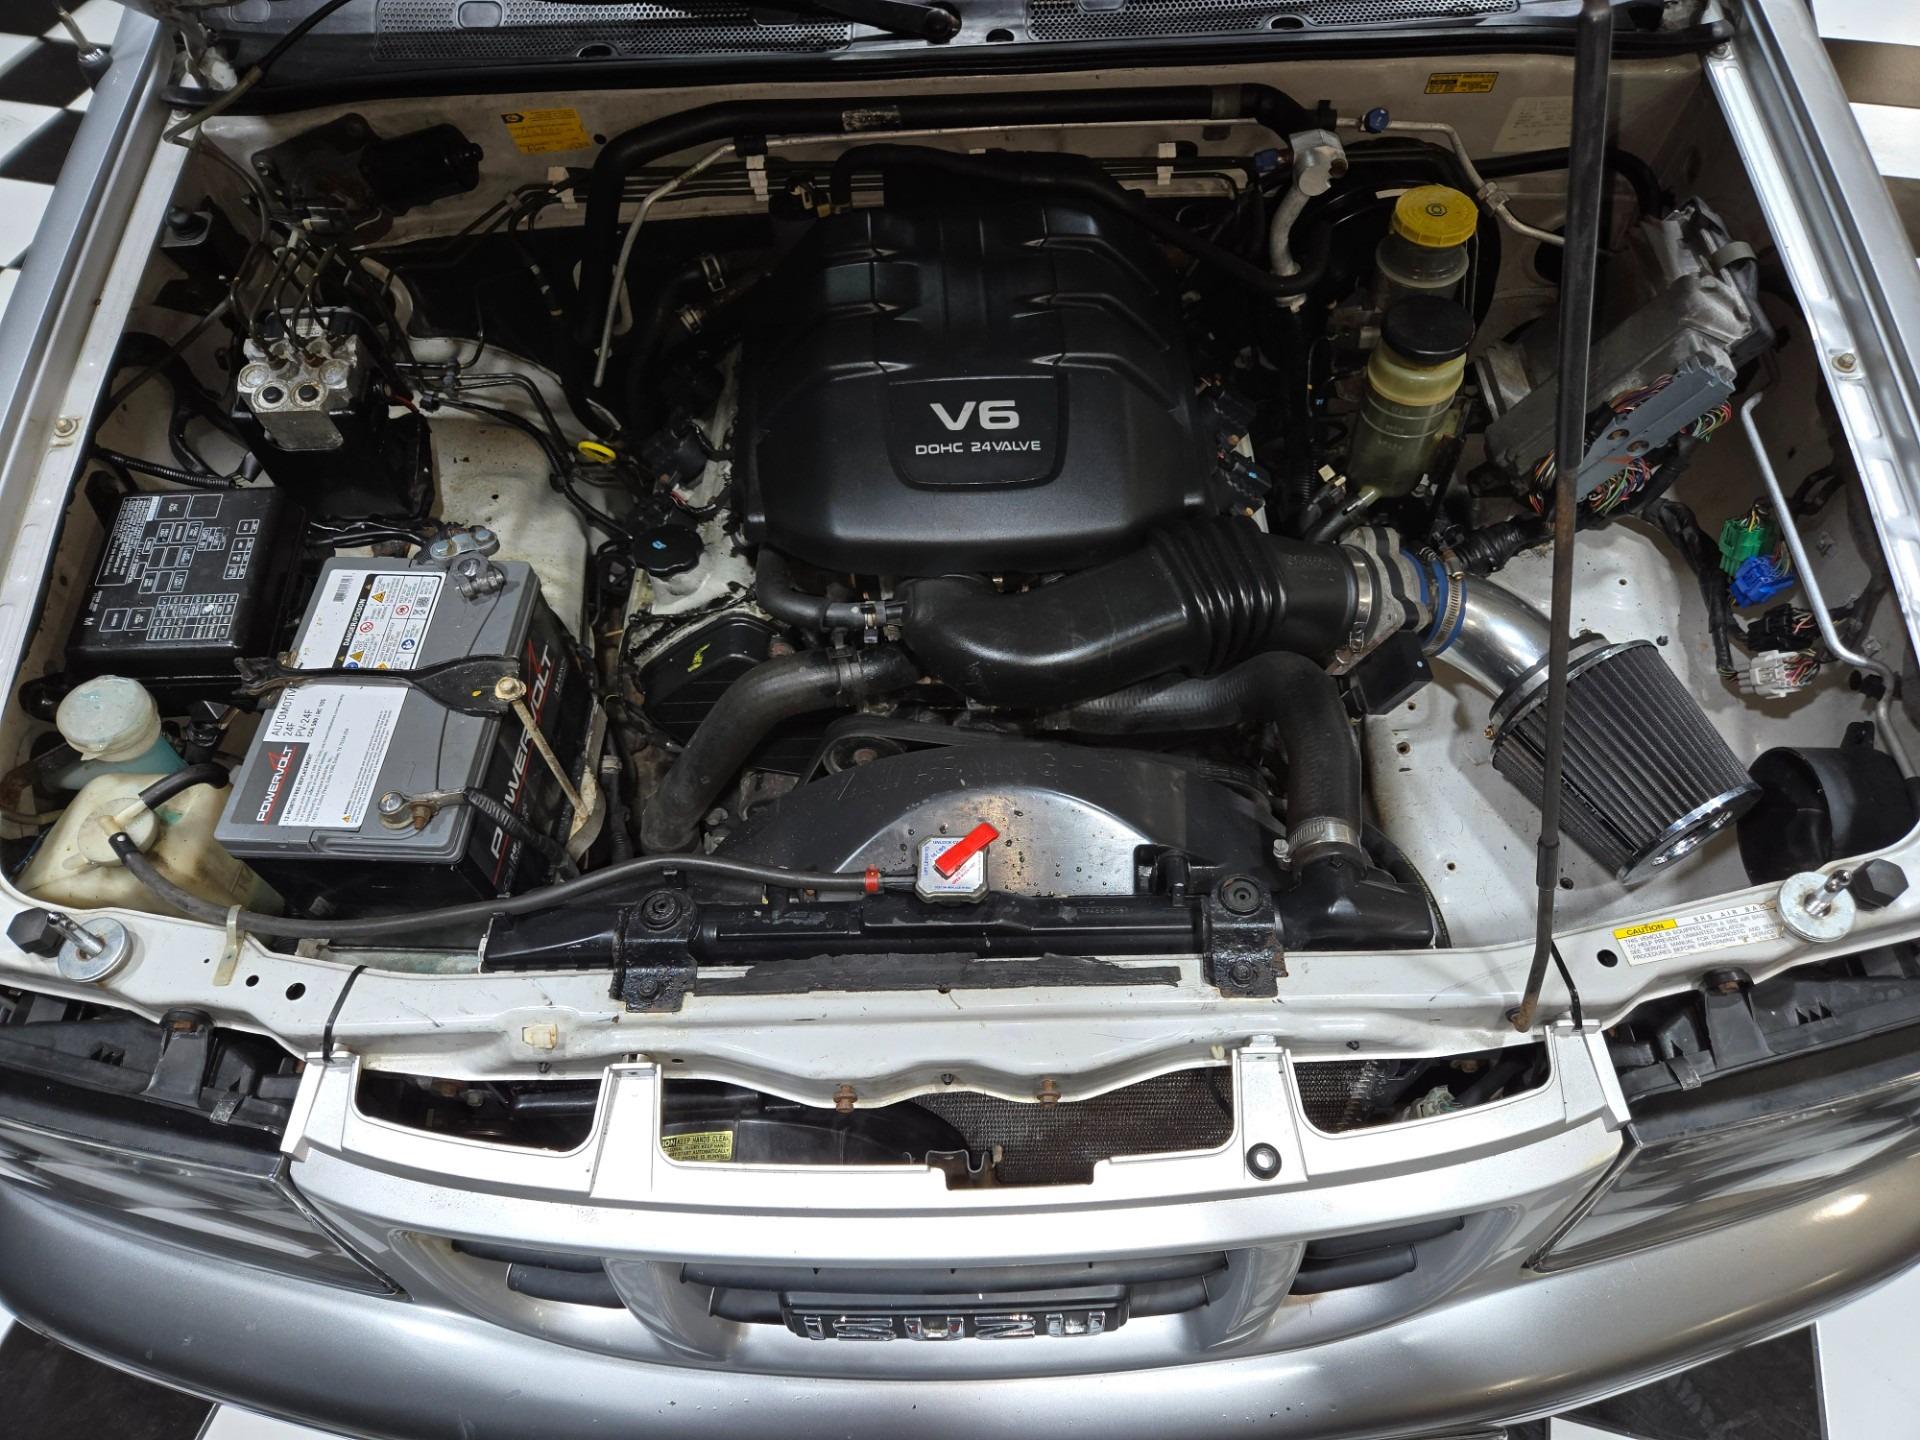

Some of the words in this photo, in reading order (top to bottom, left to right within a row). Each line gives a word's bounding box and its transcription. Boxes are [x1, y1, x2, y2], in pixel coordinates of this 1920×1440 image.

[929, 400, 1020, 430] V6
[915, 442, 964, 455] DOHC
[970, 440, 1041, 453] 24VALVE
[342, 598, 366, 645] DANGER/POISON
[283, 722, 294, 737] 24F
[295, 709, 313, 737] PV-24F
[256, 745, 292, 822] POWERVOLT
[1625, 923, 1664, 935] CAUTION
[1639, 932, 1664, 941] VEHICLE
[1671, 925, 1702, 935] EQUIPPED
[1643, 943, 1667, 951] SERVICE
[1669, 938, 1695, 946] MANUAL
[1710, 928, 1746, 939] DIAGNOSTIC
[1653, 934, 1681, 944] PREVENT
[1682, 928, 1715, 938] UNWANTED
[1631, 948, 1672, 960] PROCEDURES
[1672, 943, 1697, 952] BEFORE
[1697, 936, 1736, 947] PERFORMING
[803, 1312, 1106, 1341] ISUZU
